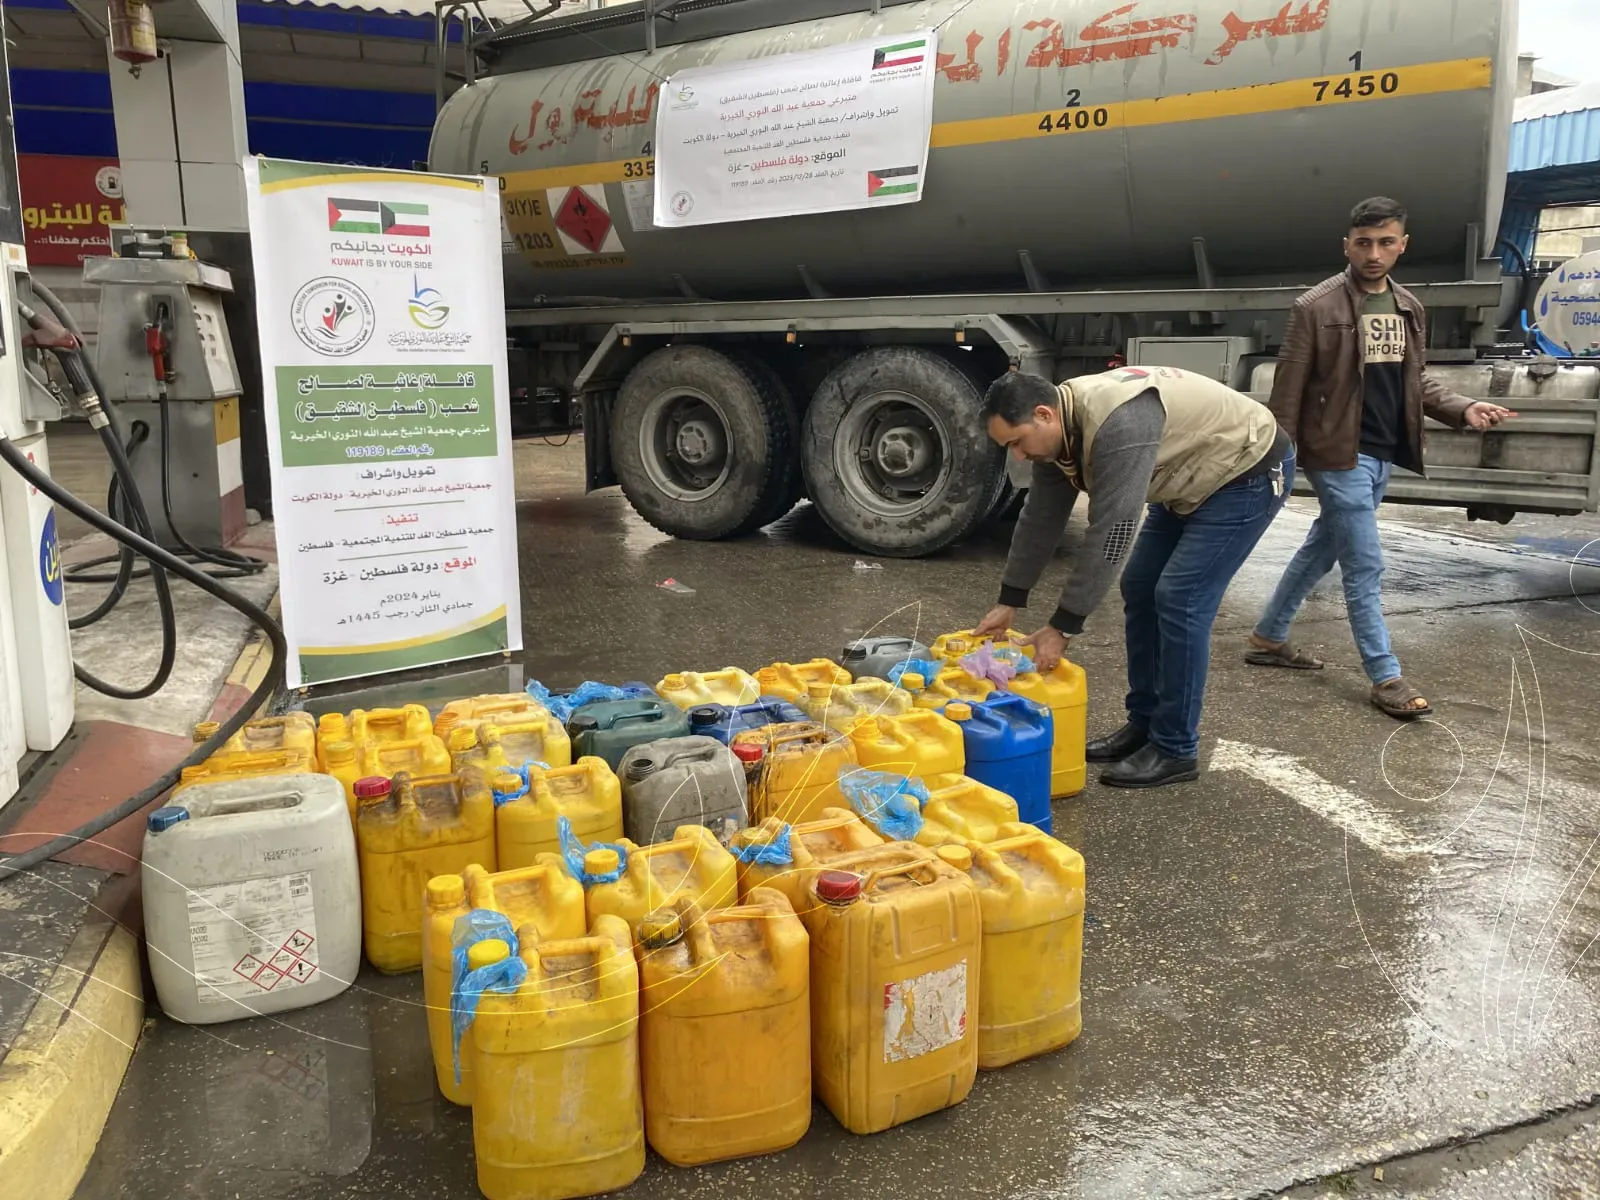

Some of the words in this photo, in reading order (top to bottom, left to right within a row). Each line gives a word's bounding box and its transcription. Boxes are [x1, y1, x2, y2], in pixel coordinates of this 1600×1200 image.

[1348, 51, 1362, 71] 1
[1312, 73, 1399, 102] 7450
[1066, 89, 1081, 107] 2
[1038, 108, 1108, 133] 4400
[642, 141, 652, 156] 4
[750, 155, 787, 172] فلسطين
[788, 154, 809, 166] دولة
[480, 161, 489, 175] 5
[23, 202, 93, 229] للبترو
[330, 240, 385, 255] بجانبكم
[516, 232, 554, 252] 1203
[387, 243, 432, 256] الكويت
[331, 257, 363, 267] KUWAIT
[366, 258, 374, 267] IS
[376, 259, 387, 267] BY
[389, 259, 412, 269] YOUR
[414, 260, 432, 269] SIDE
[297, 374, 365, 395] لصالح
[365, 372, 424, 393] إغاثية
[424, 371, 475, 388] قافلة
[440, 398, 479, 417] شعب
[290, 430, 331, 442] الخيرية
[331, 428, 362, 441] النوري
[363, 426, 379, 437] الله
[380, 429, 399, 438] عبد
[400, 426, 426, 438] الشيخ
[427, 426, 456, 437] جمعية
[345, 445, 385, 457] 119189
[416, 443, 434, 458] رقم
[402, 465, 436, 478] تمويل
[412, 484, 427, 493] الله
[427, 486, 443, 494] عبد
[444, 483, 466, 493] الشيخ
[466, 482, 492, 490] جمعية
[291, 492, 322, 503] الكويت
[323, 491, 343, 500] دولة
[349, 489, 385, 499] الخيرية
[384, 532, 416, 544] للتنمية
[417, 531, 434, 539] الغد
[435, 528, 467, 539] فلسطين
[468, 527, 495, 536] جمعية
[298, 540, 334, 553] فلسطين
[341, 535, 384, 548] المجتمعية
[360, 563, 409, 580] فلسطين
[410, 561, 439, 574] دولة
[323, 570, 349, 584] غزة
[420, 589, 441, 602] يناير
[385, 611, 409, 619] رجب
